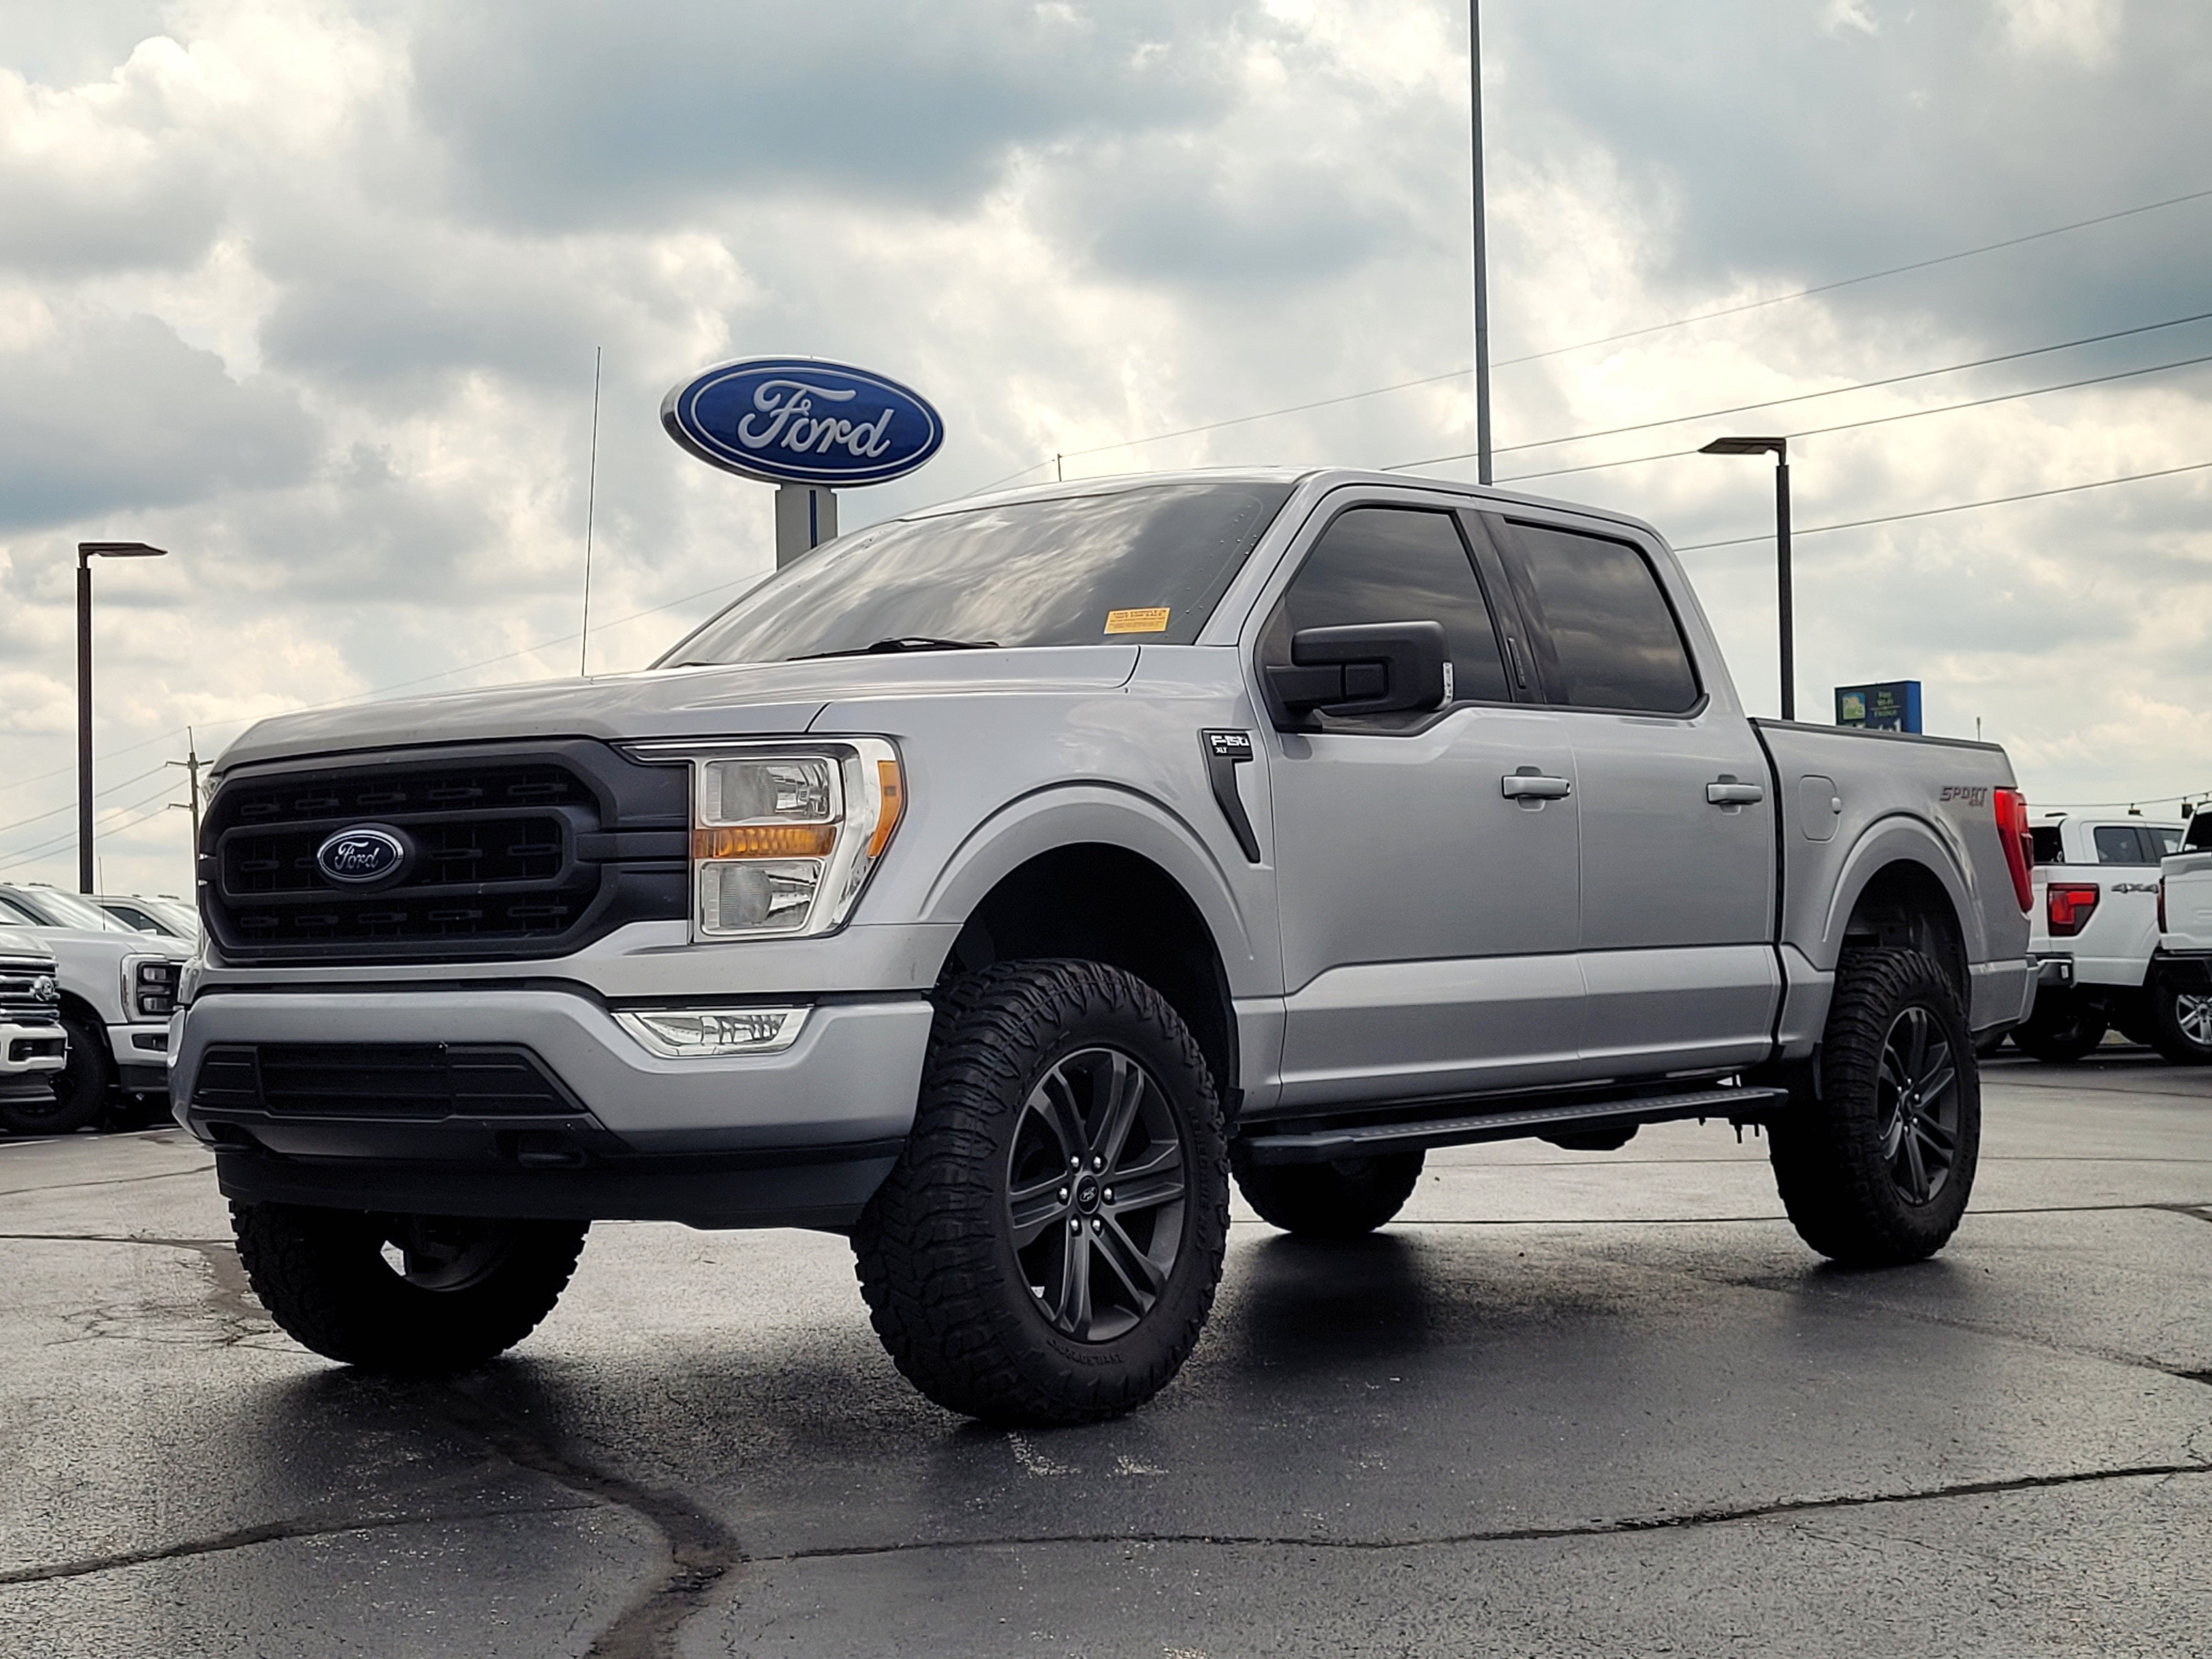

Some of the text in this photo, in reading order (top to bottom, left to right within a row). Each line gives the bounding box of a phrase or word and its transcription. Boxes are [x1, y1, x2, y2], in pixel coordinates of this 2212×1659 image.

[737, 380, 894, 458] Ford
[1210, 735, 1250, 746] F-150
[1939, 786, 1988, 802] SPORT
[334, 841, 380, 870] Ford
